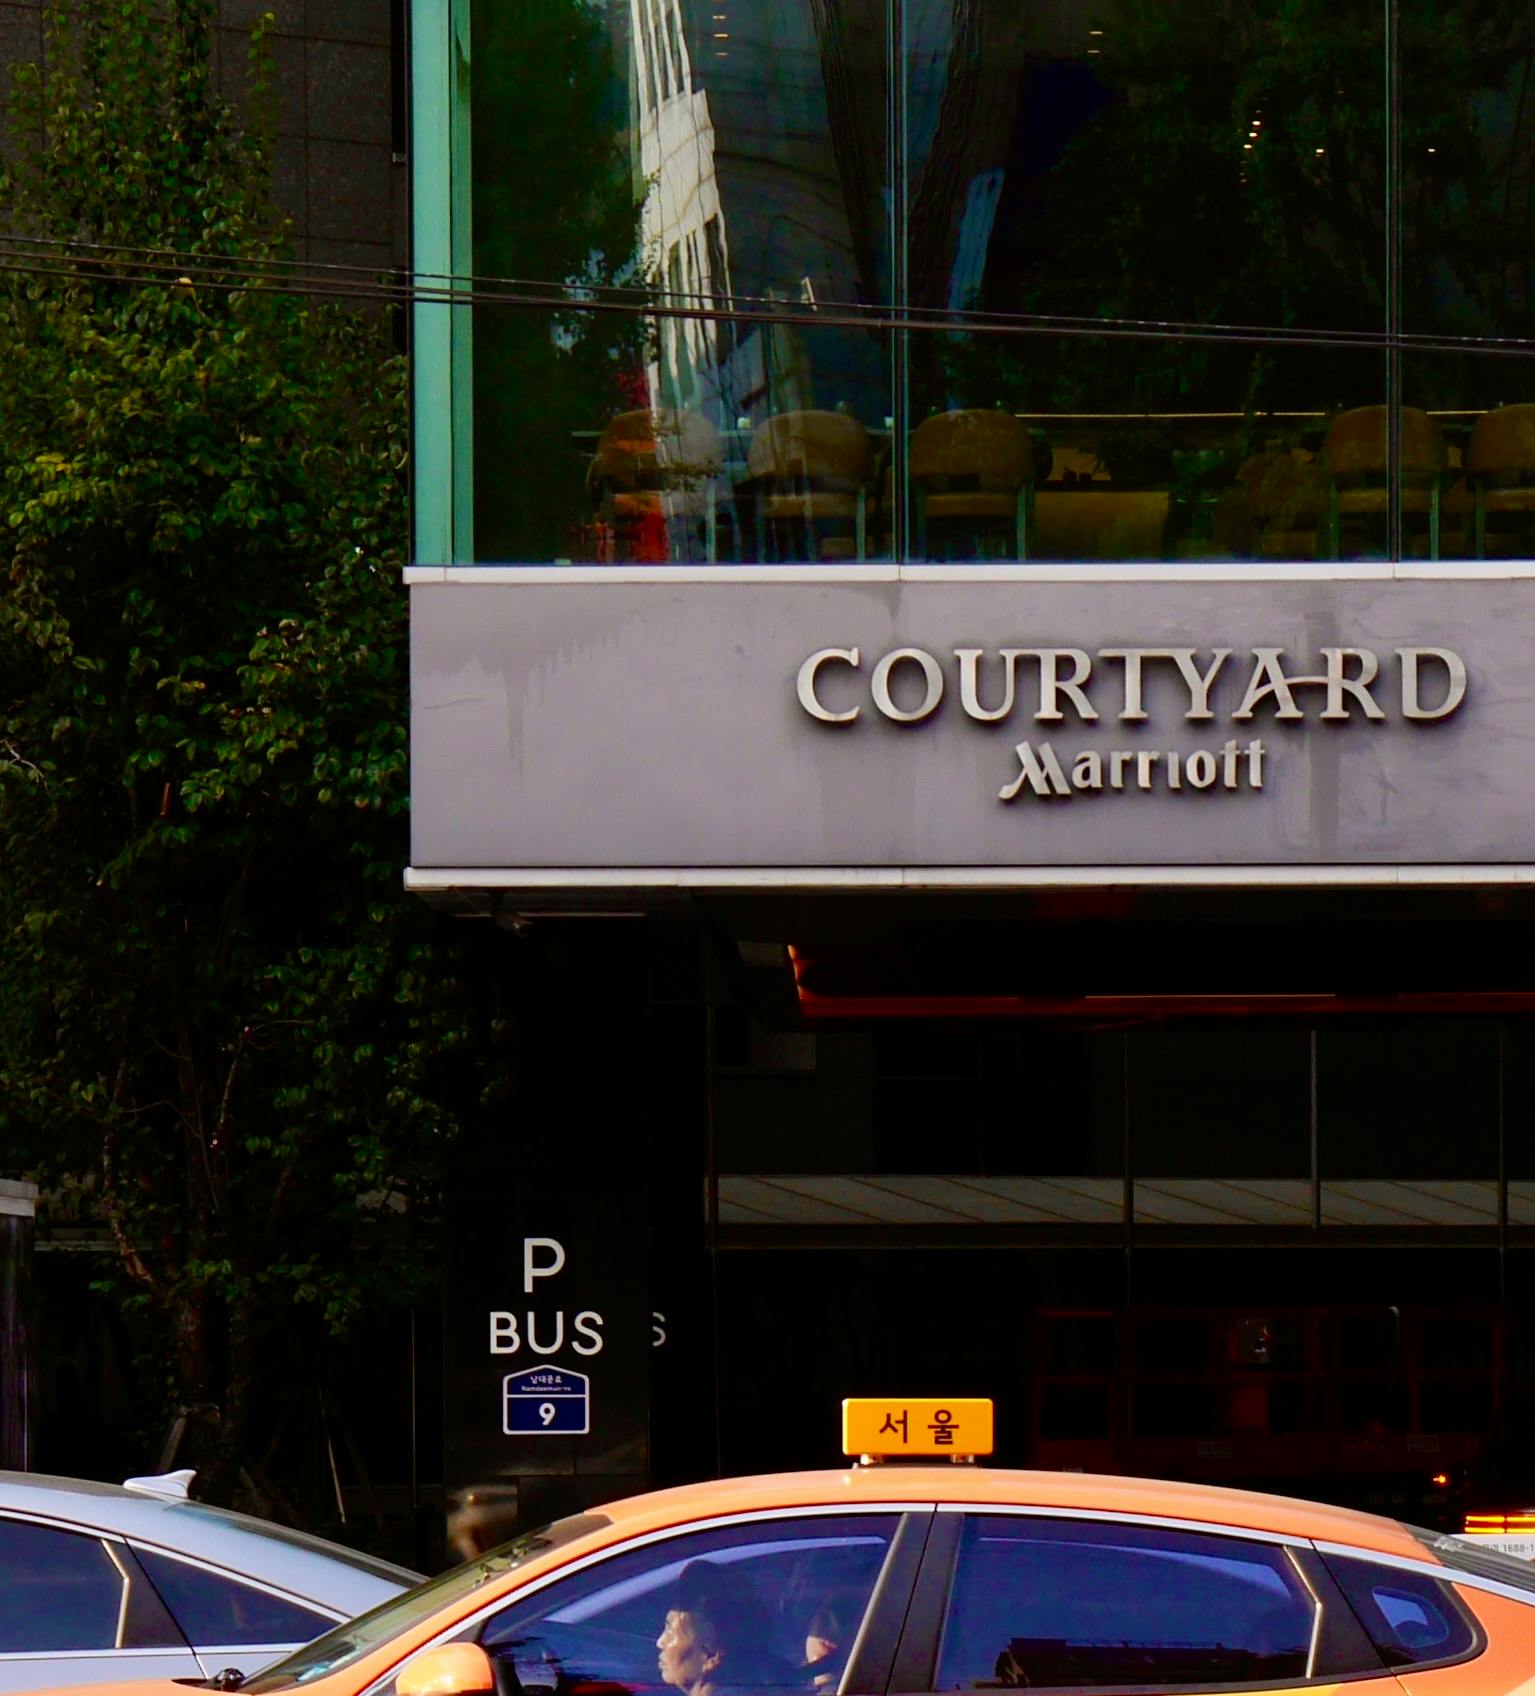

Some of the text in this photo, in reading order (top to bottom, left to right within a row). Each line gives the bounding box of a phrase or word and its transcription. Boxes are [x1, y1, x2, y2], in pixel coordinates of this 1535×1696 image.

[796, 646, 1468, 722] COURTYARD
[997, 739, 1266, 800] Marriott
[523, 1237, 566, 1293] P
[489, 1310, 604, 1356] BUS
[538, 1401, 556, 1426] 9
[878, 1408, 960, 1446] 서울
